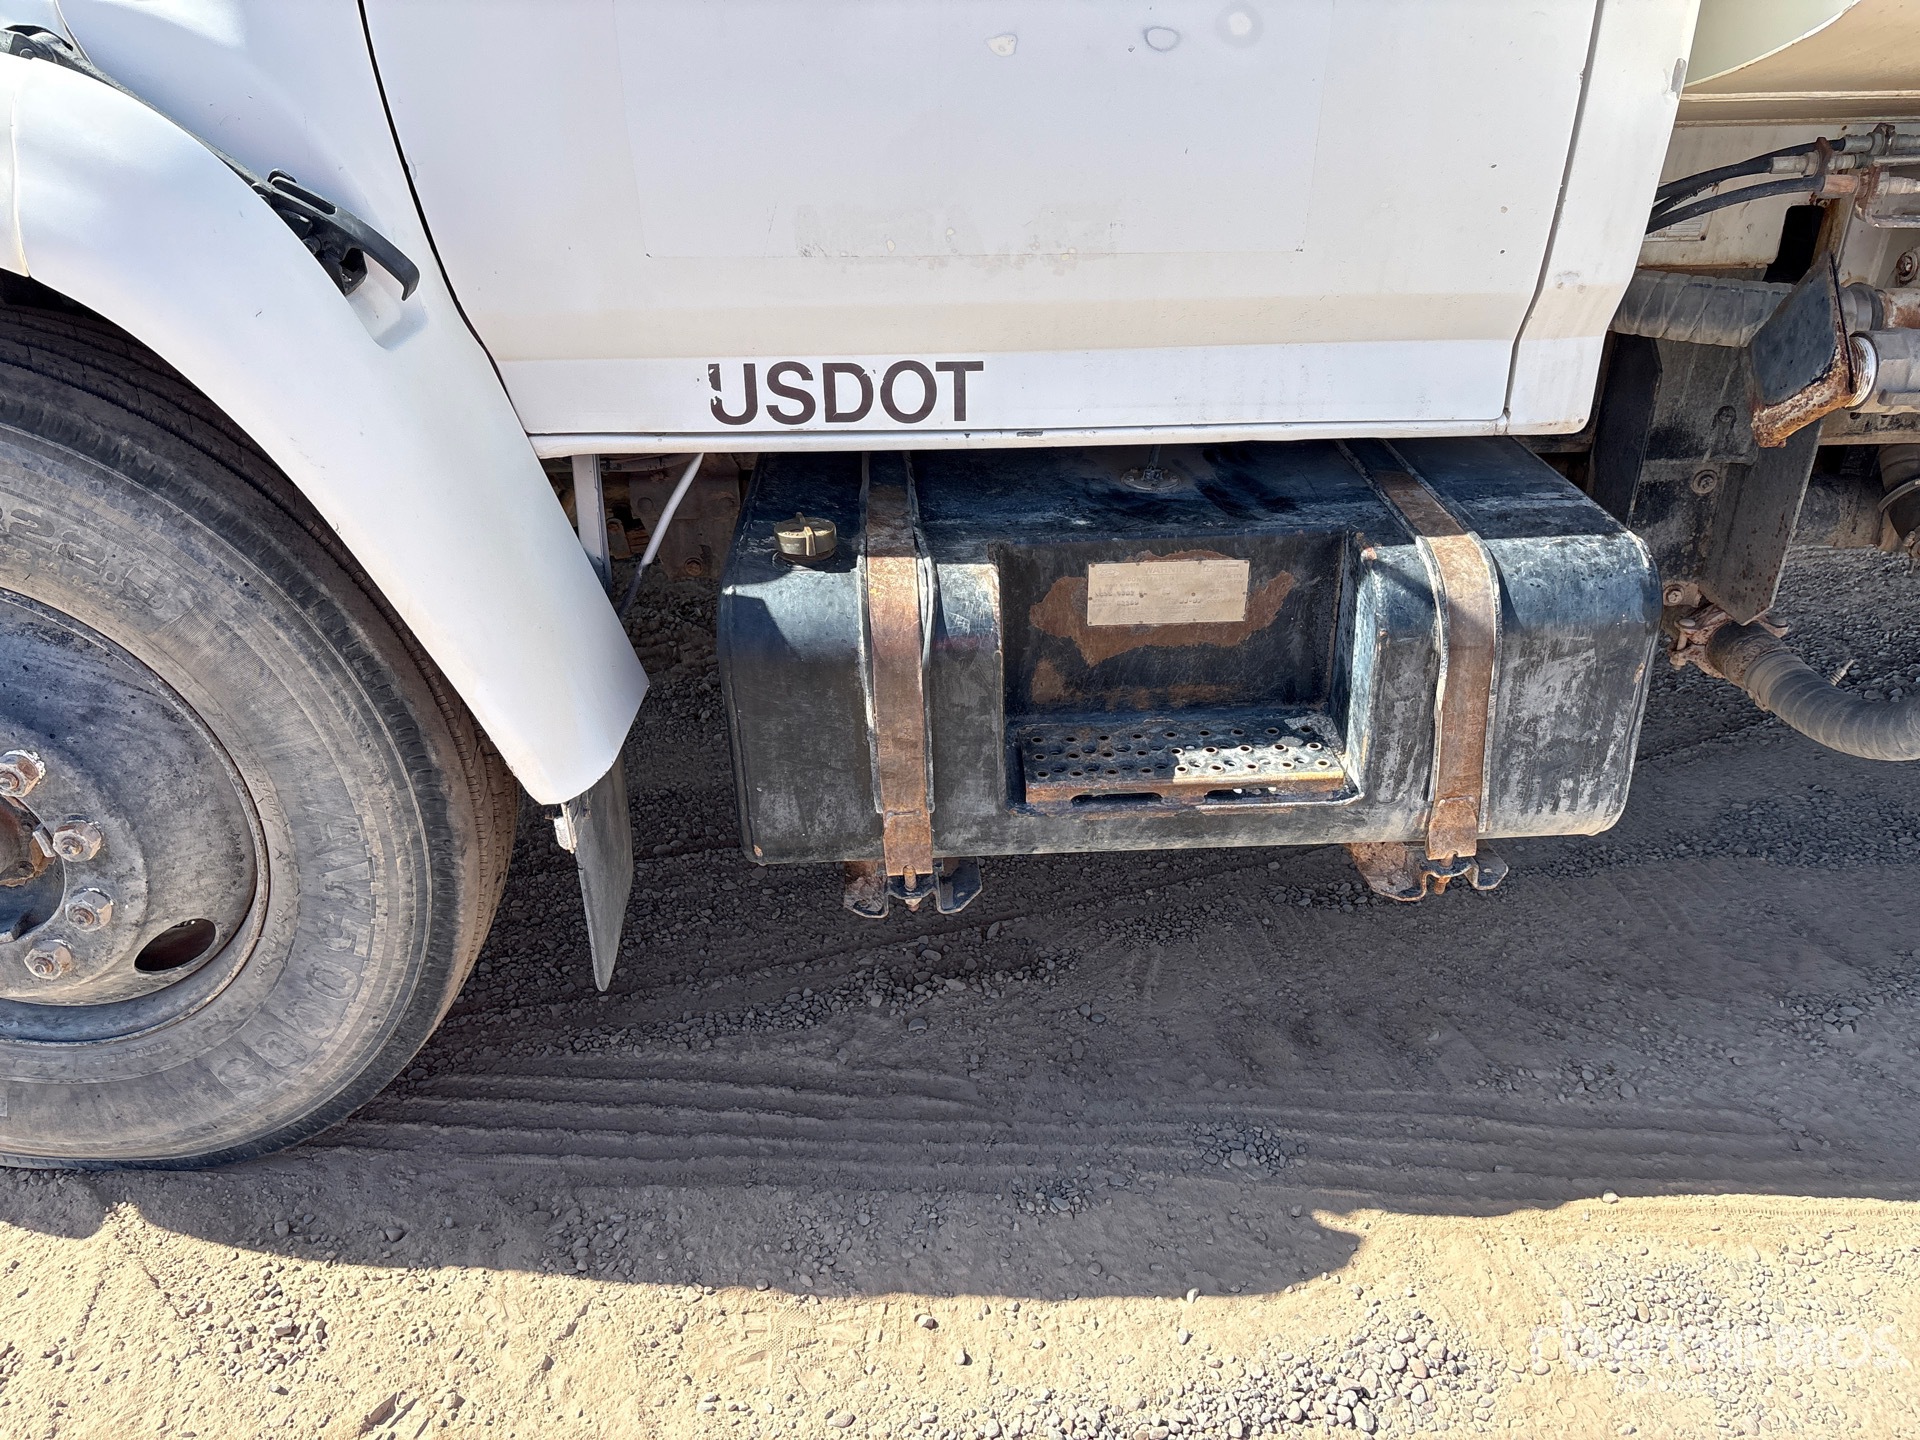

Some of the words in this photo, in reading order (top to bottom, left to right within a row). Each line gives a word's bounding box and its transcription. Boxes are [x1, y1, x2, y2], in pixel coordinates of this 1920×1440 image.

[707, 359, 984, 425] USDOT
[0, 507, 172, 610] 22.5
[1145, 565, 1195, 574] WARNING
